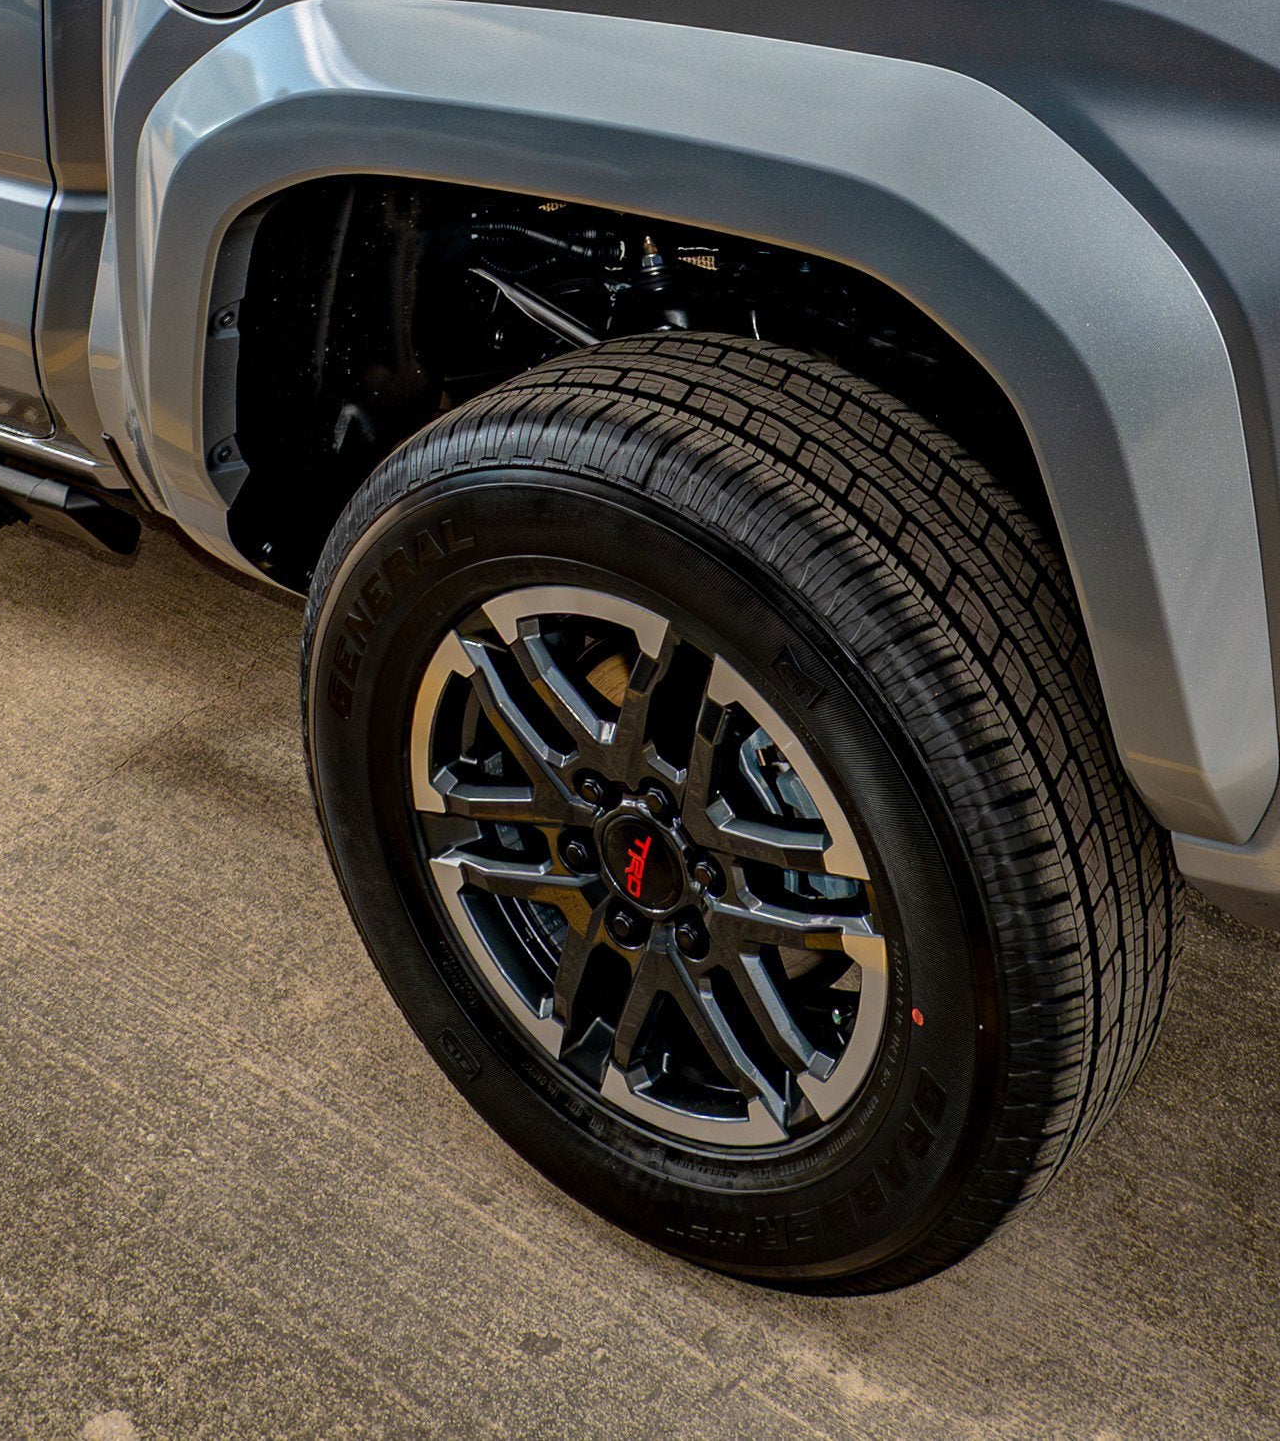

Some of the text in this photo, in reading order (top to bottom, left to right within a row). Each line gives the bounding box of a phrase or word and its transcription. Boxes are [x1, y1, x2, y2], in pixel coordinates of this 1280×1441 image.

[326, 518, 476, 721] GENERAL
[624, 835, 652, 898] TRD
[754, 1066, 948, 1250] GRABBER
